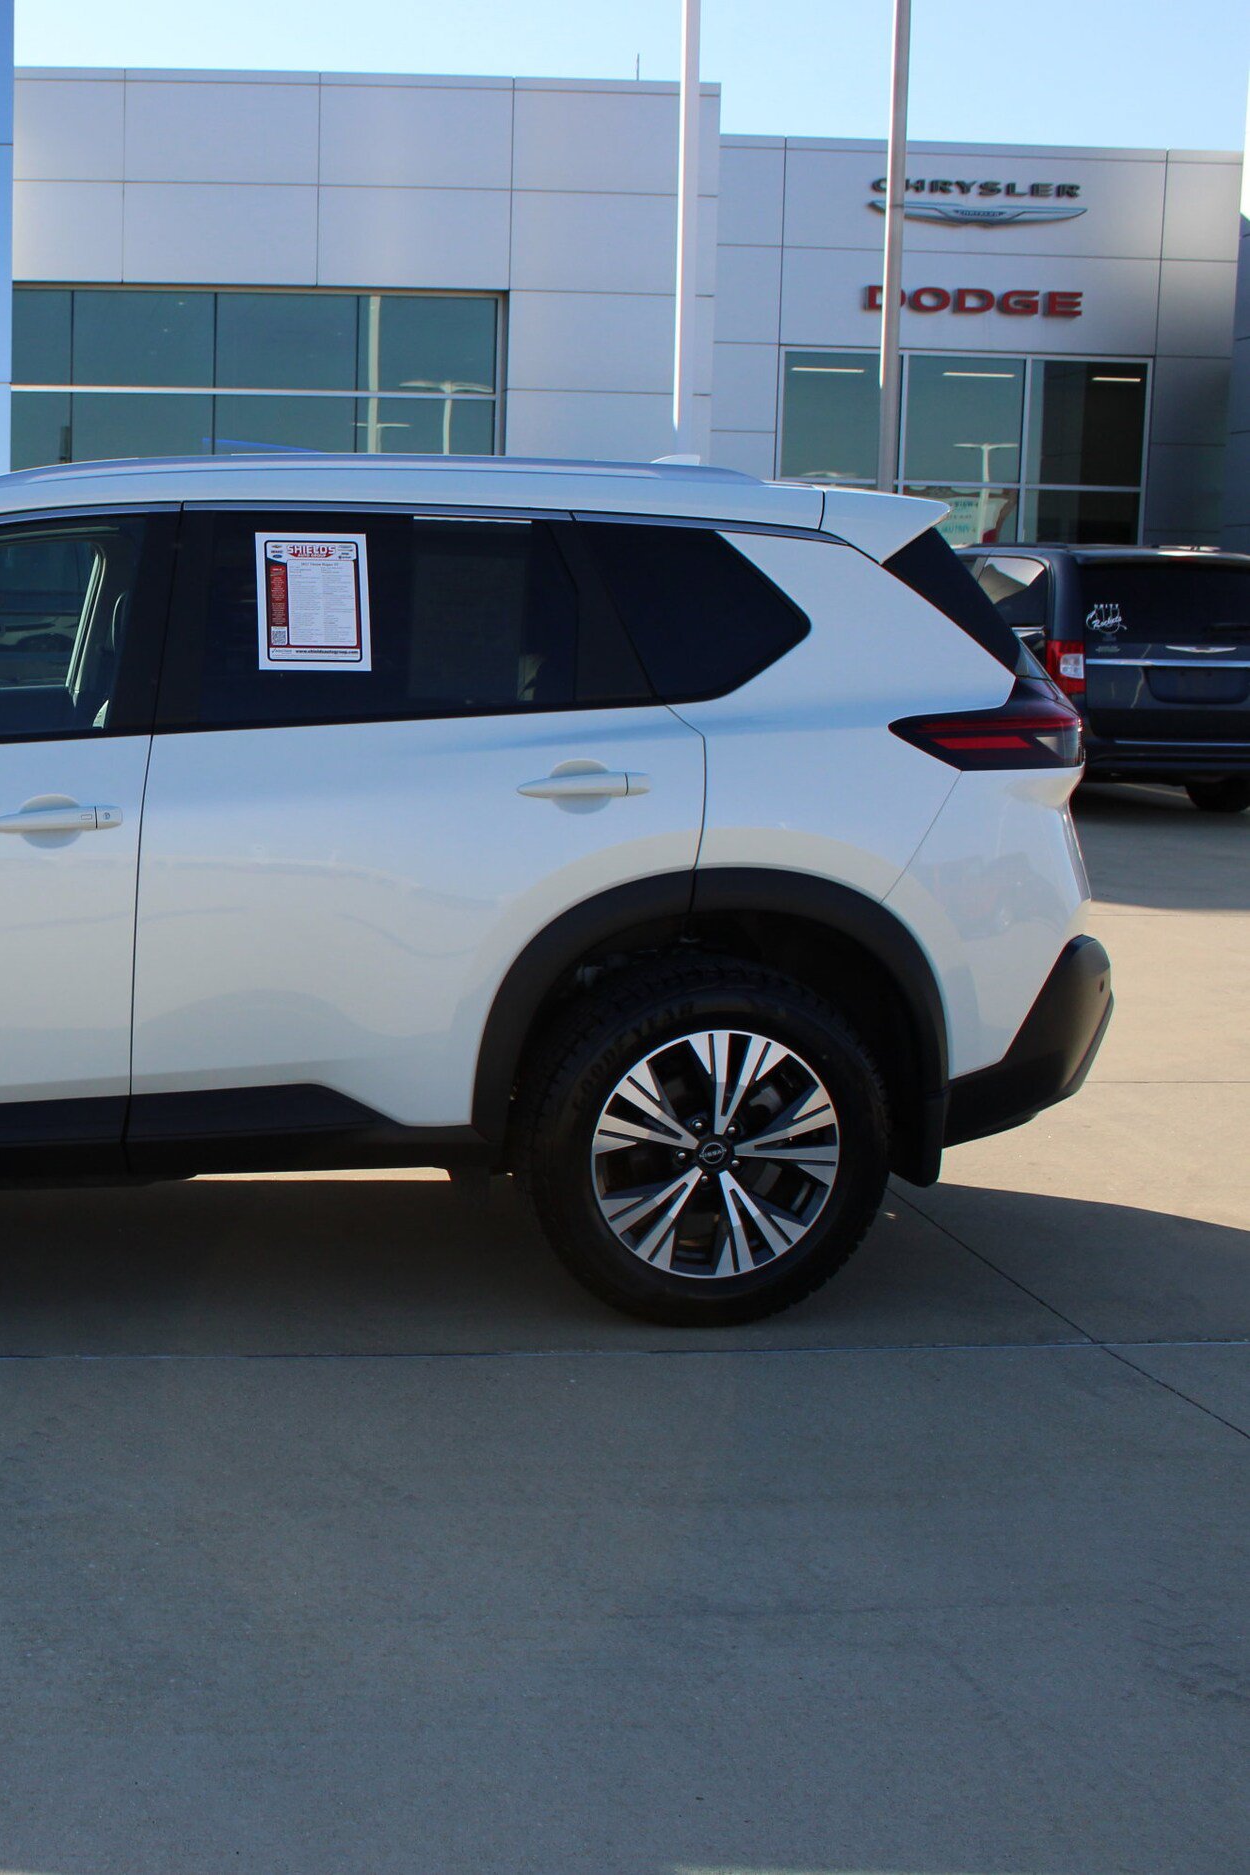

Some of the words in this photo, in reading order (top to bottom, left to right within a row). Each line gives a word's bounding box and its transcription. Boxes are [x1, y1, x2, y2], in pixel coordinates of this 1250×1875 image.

[871, 177, 1081, 198] CHRYSLER
[865, 284, 1083, 317] DODGE
[287, 545, 336, 554] SHIELDS
[698, 1147, 727, 1158] NISSAN
